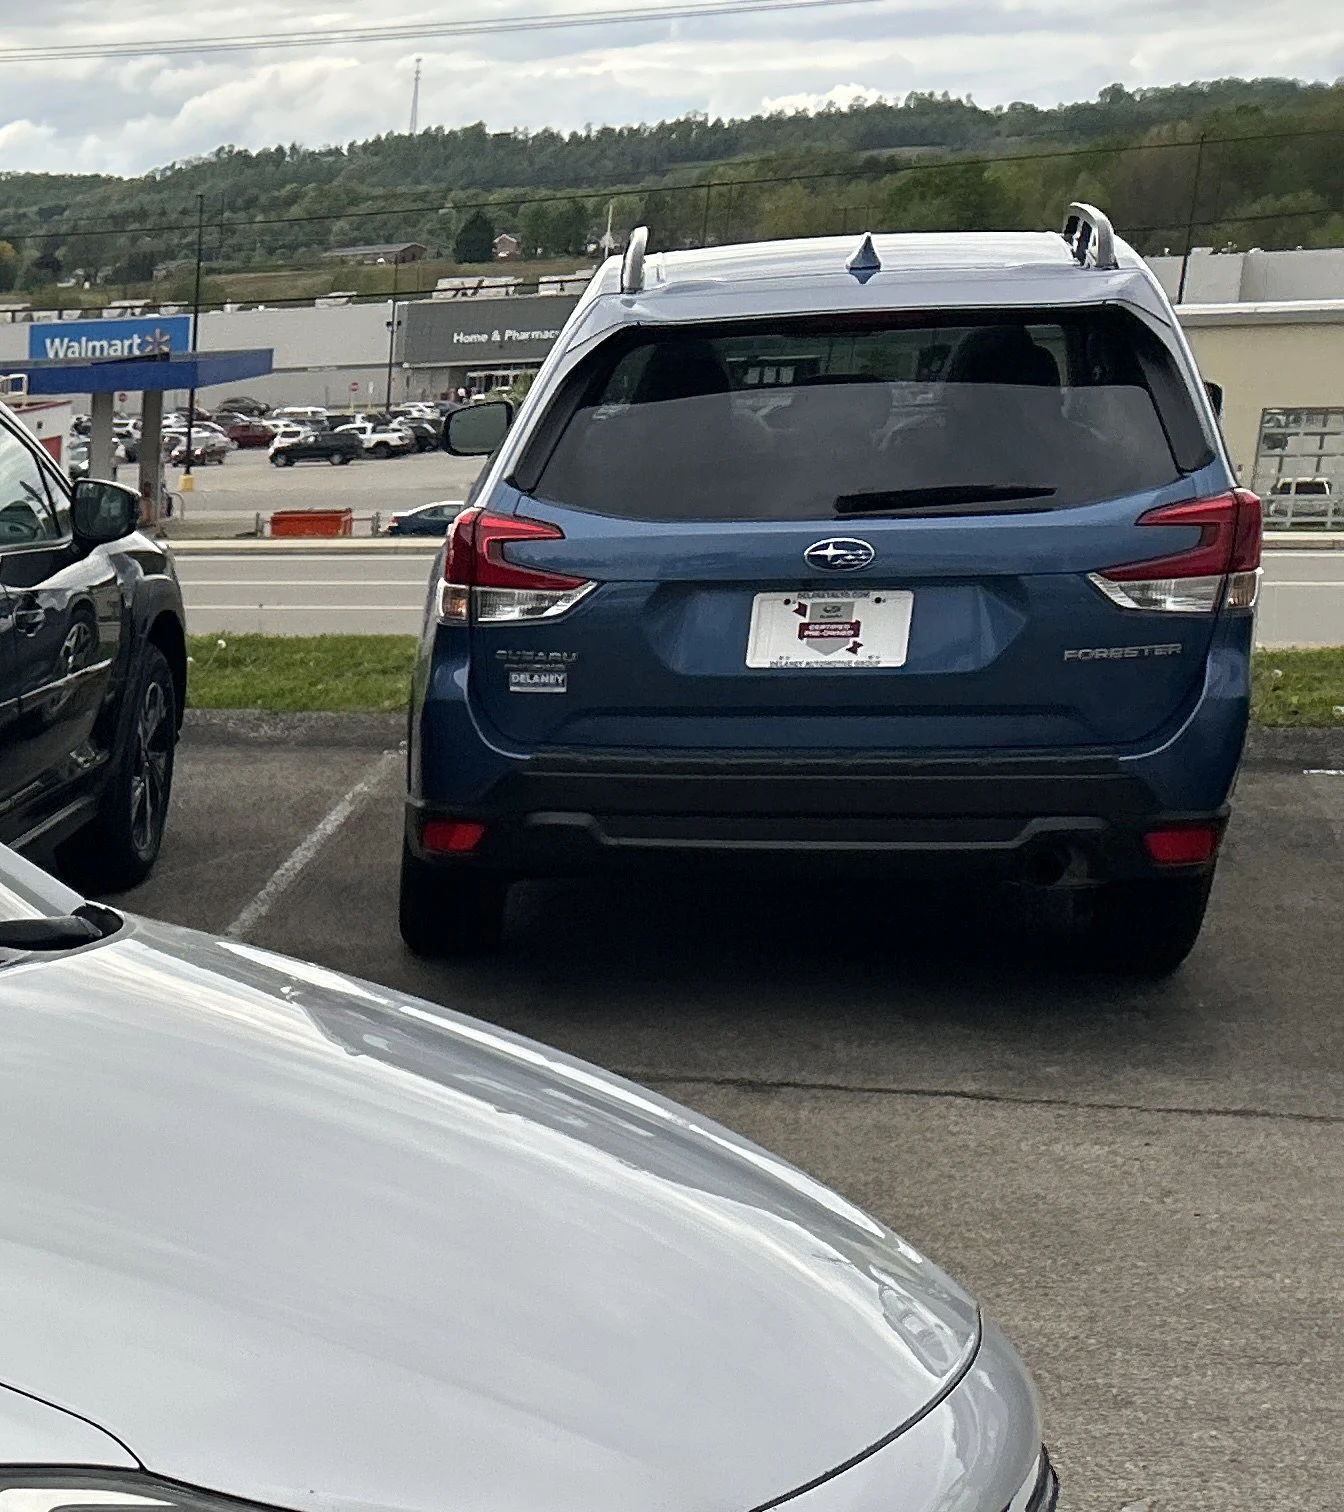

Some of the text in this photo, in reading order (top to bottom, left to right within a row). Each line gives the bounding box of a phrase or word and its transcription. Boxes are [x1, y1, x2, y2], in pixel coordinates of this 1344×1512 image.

[453, 332, 488, 343] Home
[45, 333, 142, 359] Walmart
[1064, 643, 1182, 661] FORESTER
[511, 673, 565, 685] DELANEY
